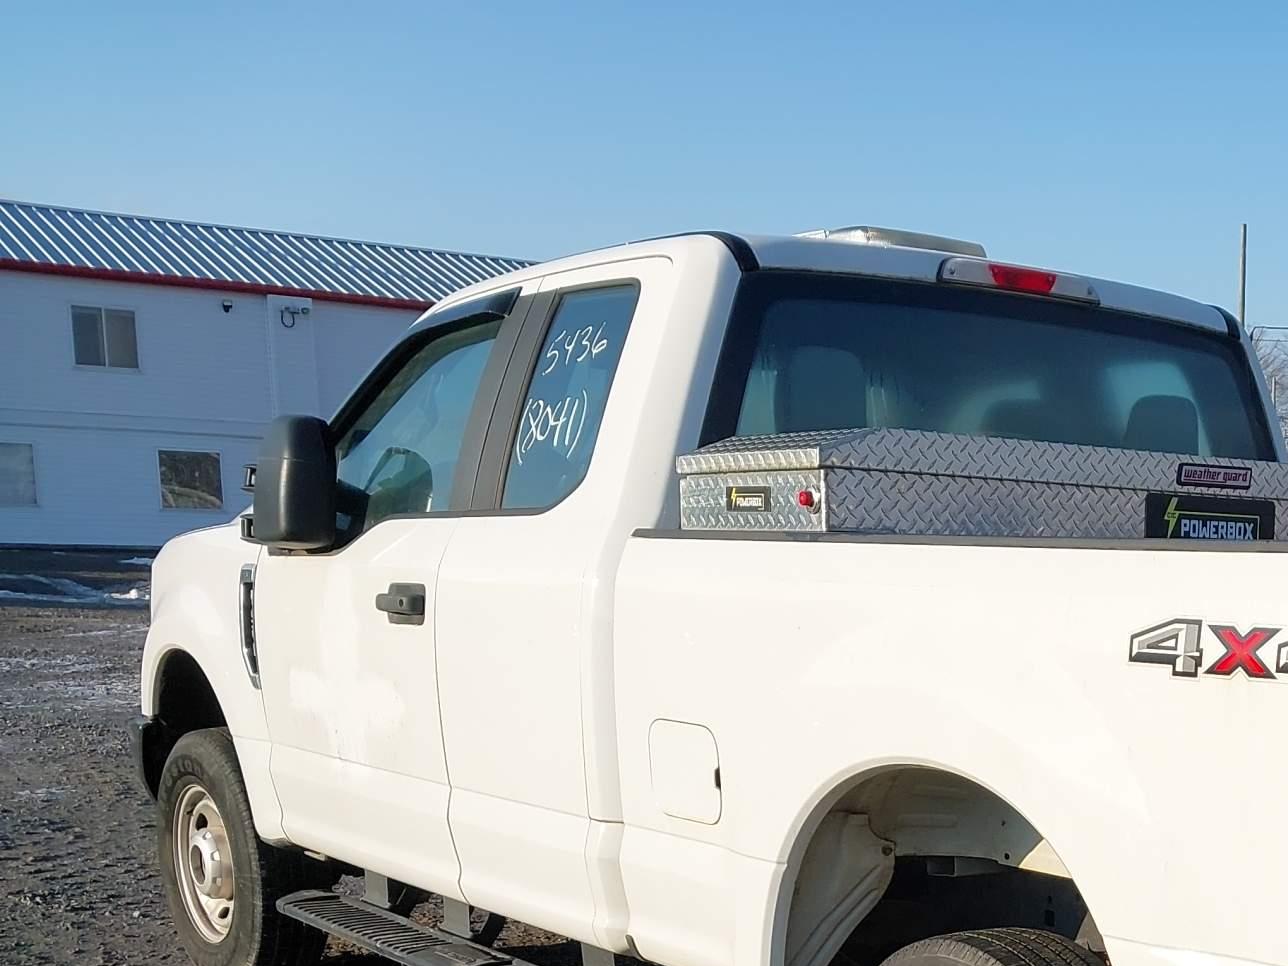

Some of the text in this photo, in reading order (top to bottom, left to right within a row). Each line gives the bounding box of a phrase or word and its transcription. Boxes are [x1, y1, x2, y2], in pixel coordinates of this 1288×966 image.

[541, 321, 608, 376] 5436
[516, 389, 588, 465] (8041)
[1183, 467, 1249, 482] weather guard
[1180, 518, 1255, 540] POWERBOX
